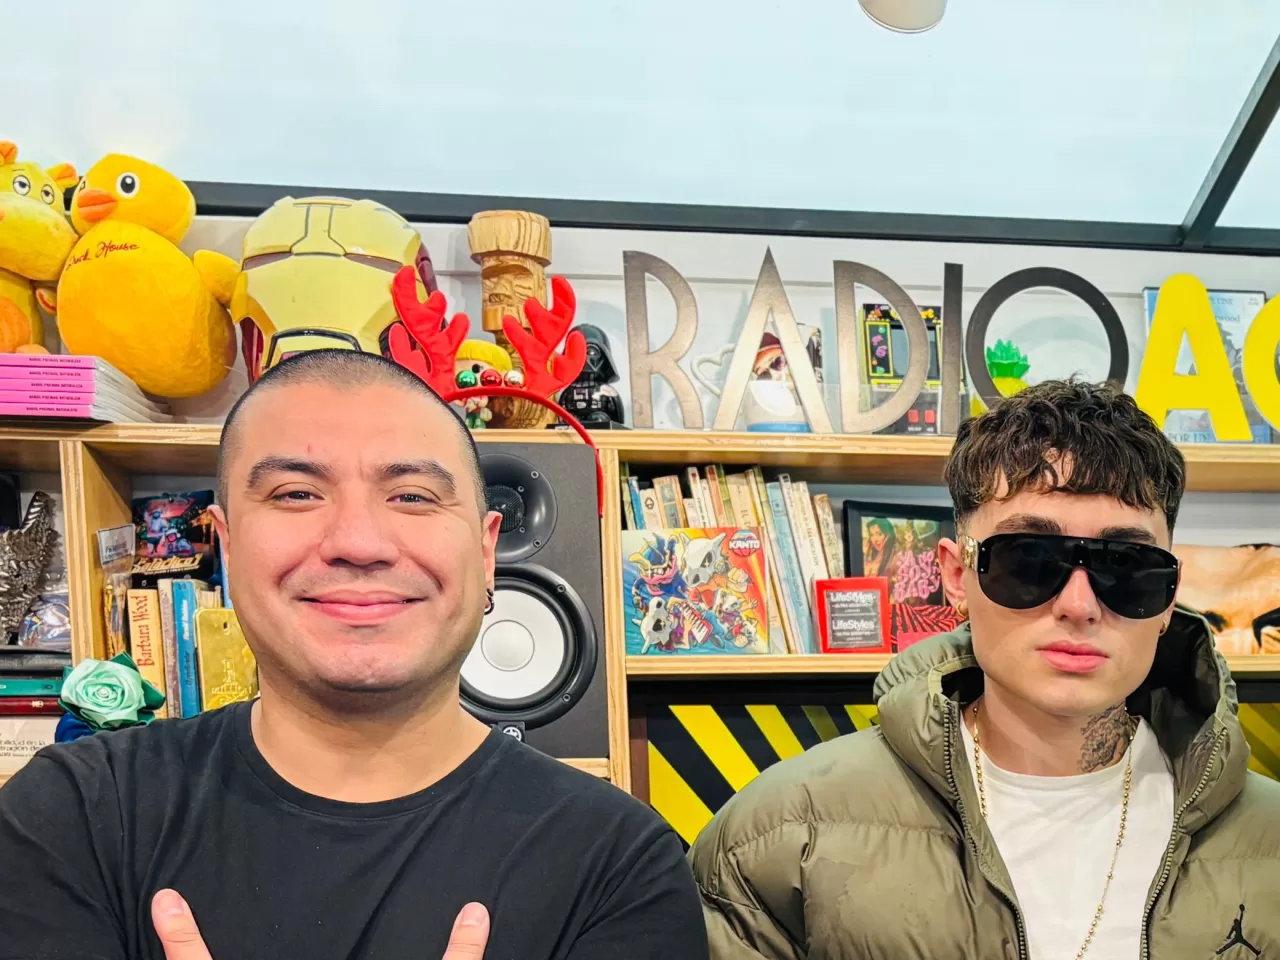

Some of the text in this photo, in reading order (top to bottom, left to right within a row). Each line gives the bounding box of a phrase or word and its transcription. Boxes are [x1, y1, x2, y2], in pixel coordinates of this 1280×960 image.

[728, 538, 761, 550] KANTO
[832, 619, 875, 631] LifeStyles
[137, 623, 155, 668] Barbara
